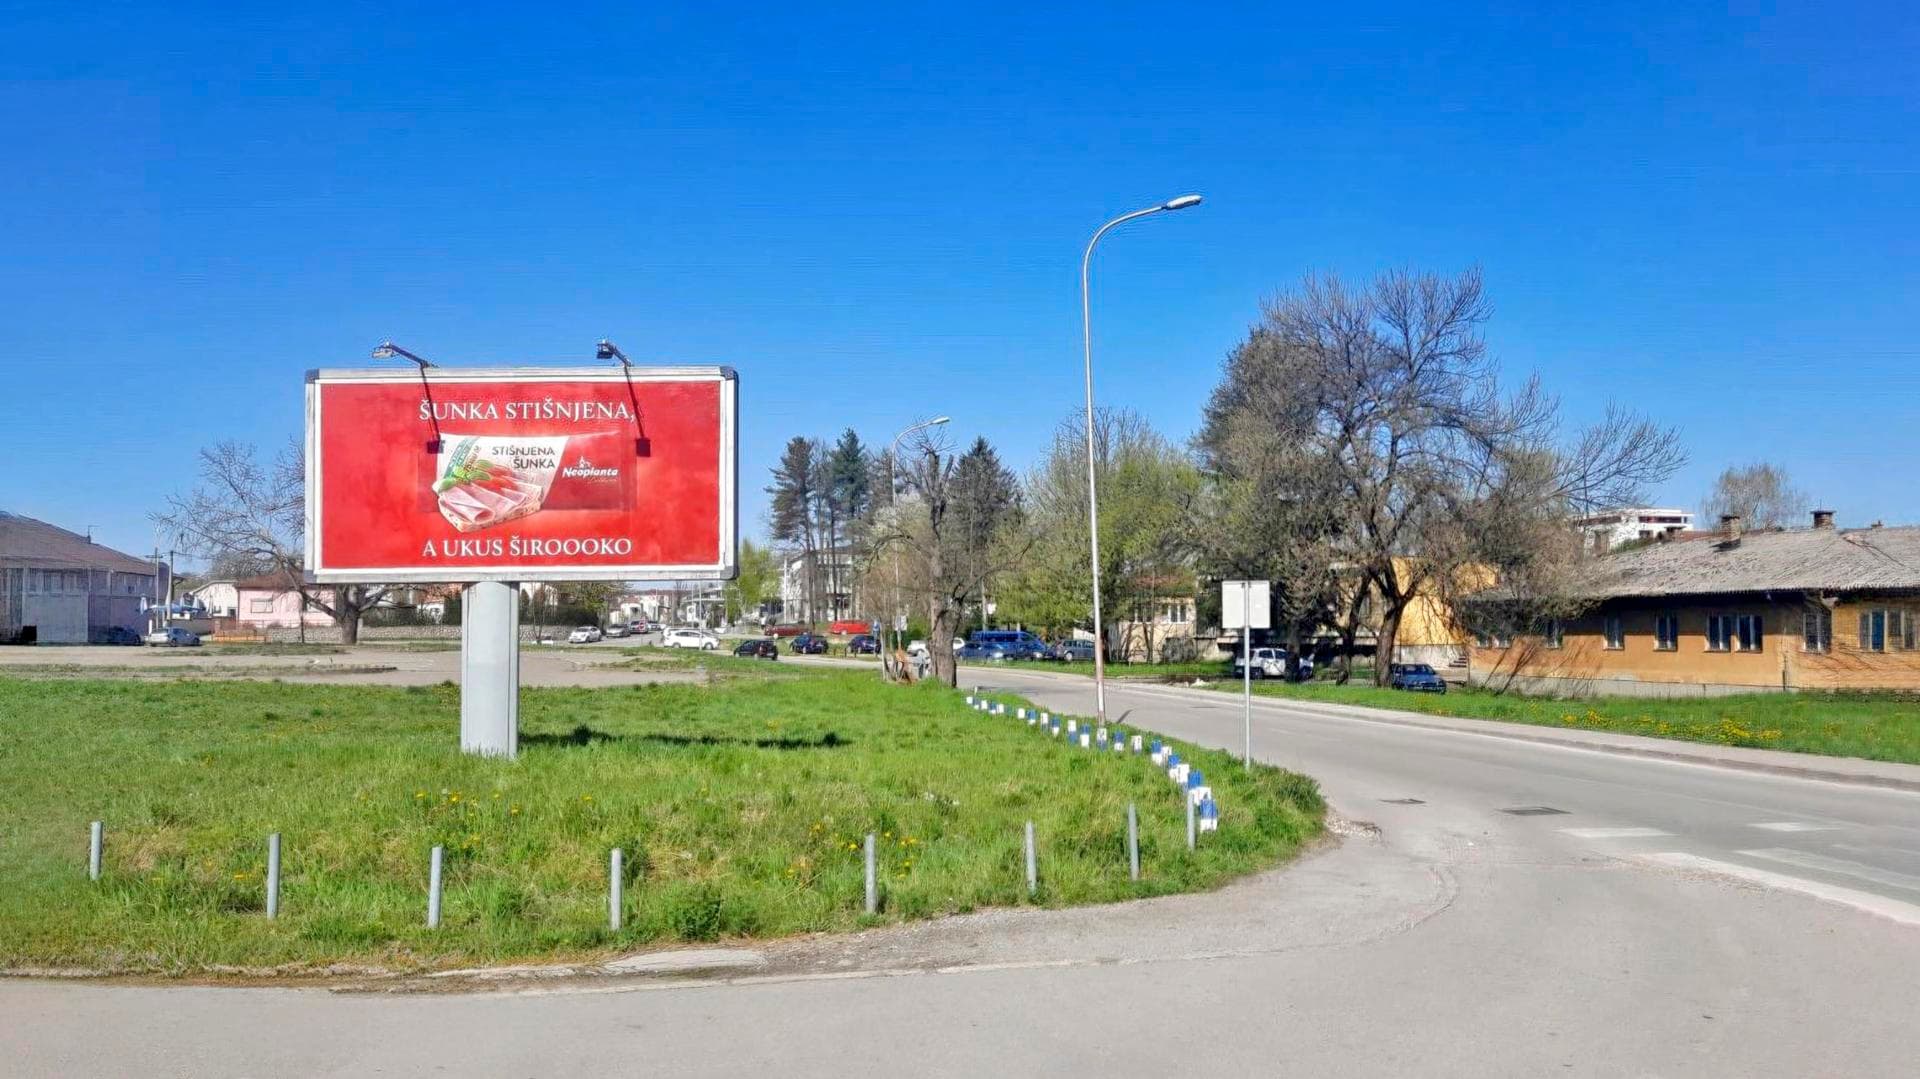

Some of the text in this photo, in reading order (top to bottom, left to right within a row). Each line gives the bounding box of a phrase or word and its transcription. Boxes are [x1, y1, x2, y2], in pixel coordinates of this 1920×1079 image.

[420, 396, 635, 423] ŠUNKA STIŠNJENA,
[491, 445, 556, 456] STIŠNJENA
[513, 456, 556, 469] ŠUNKA
[562, 467, 619, 478] Neoplanta
[422, 535, 632, 556] A UKUS ŠIROOOKO
